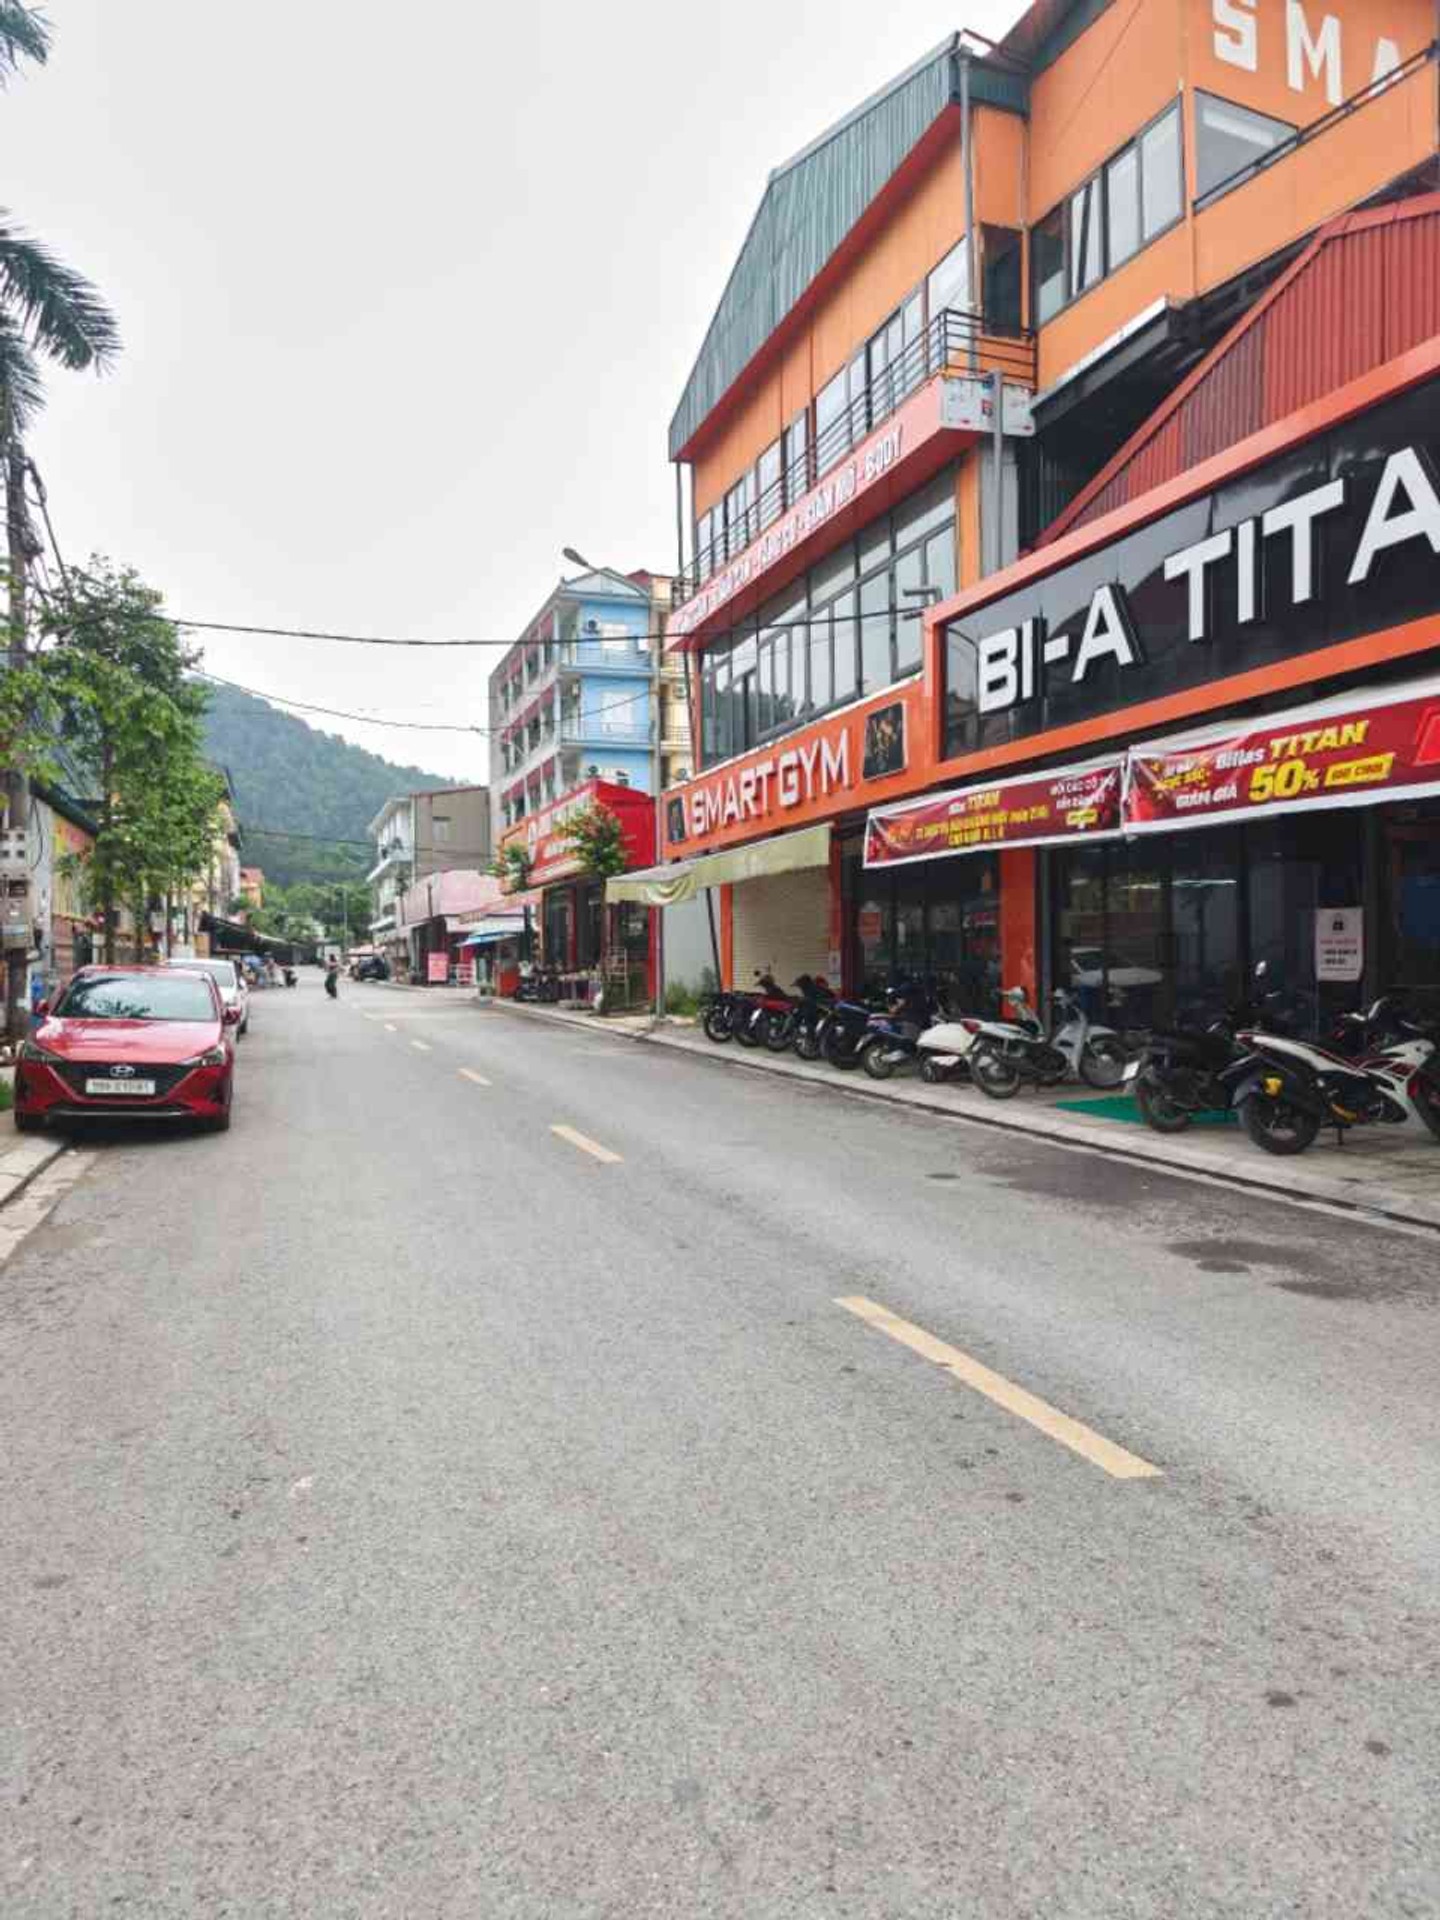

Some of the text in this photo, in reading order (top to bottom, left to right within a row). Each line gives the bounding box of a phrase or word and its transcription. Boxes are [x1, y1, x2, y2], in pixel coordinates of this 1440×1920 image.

[979, 446, 1440, 713] BI-A TITA
[1269, 720, 1369, 758] TITAN
[1249, 759, 1320, 803] 50%
